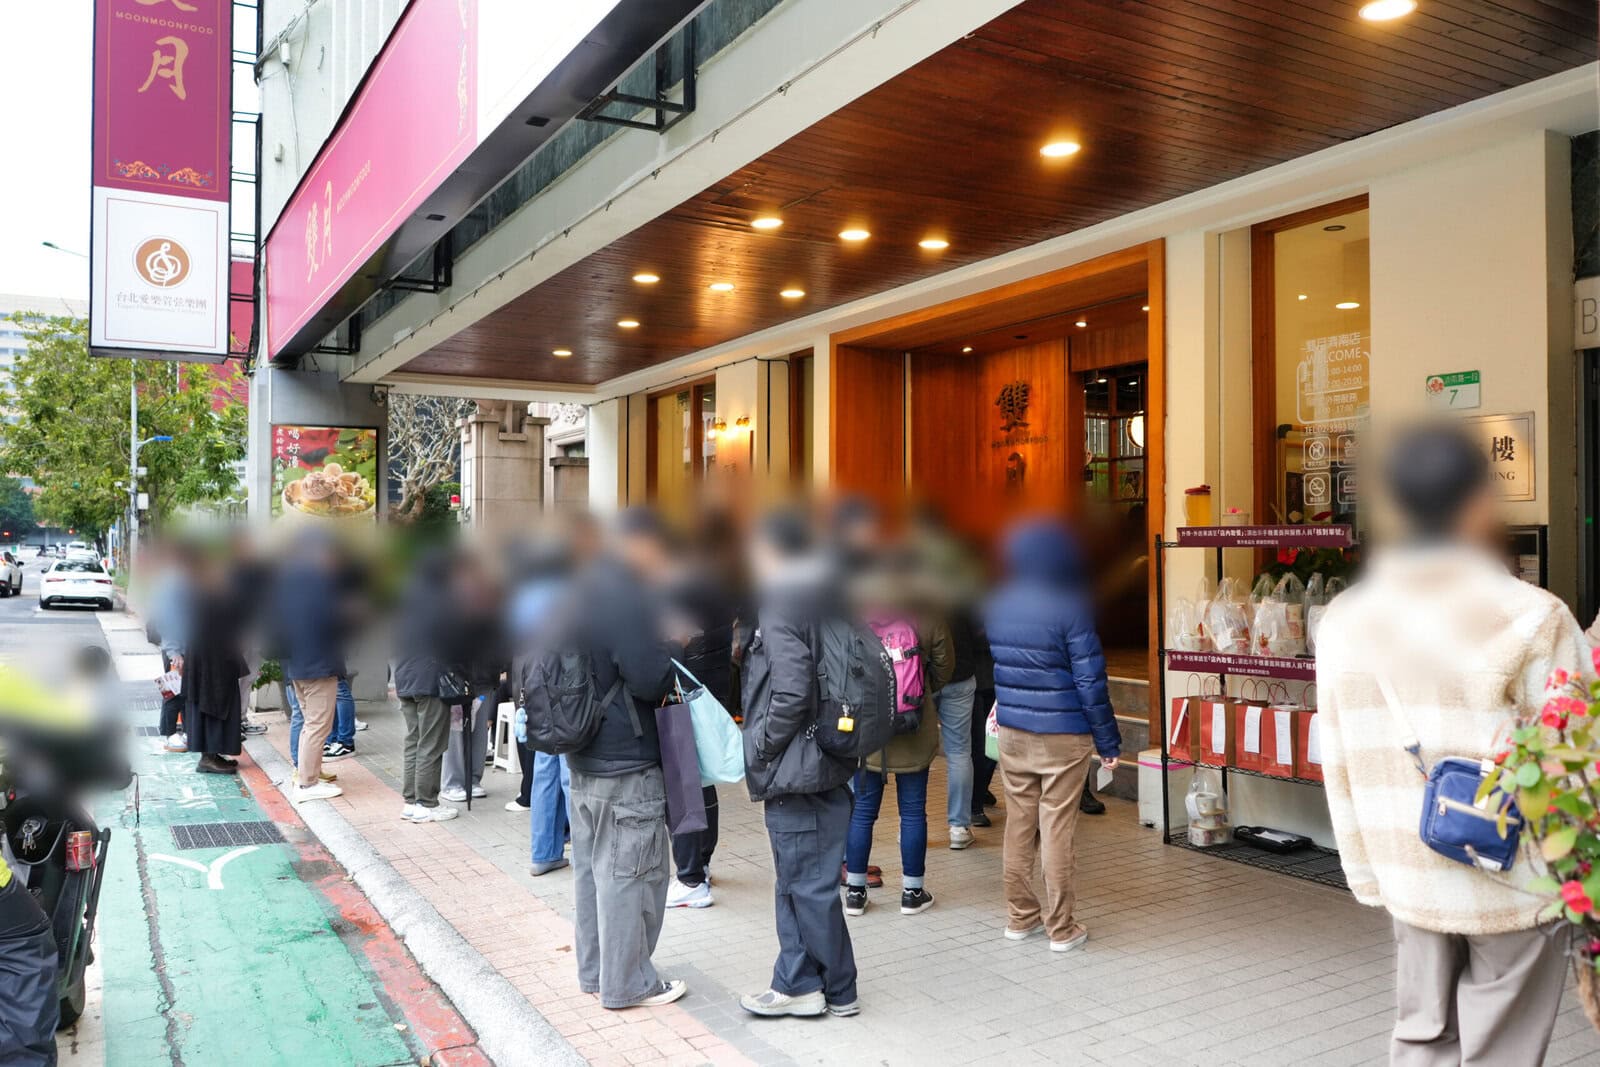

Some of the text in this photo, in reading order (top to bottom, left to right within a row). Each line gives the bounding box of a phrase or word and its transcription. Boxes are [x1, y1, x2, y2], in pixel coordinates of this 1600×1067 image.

[115, 11, 214, 34] MOONMOONFOOD
[137, 36, 189, 100] 月
[1449, 388, 1459, 406] 7
[287, 428, 301, 469] 喝好湯
[1491, 435, 1516, 463] 樓
